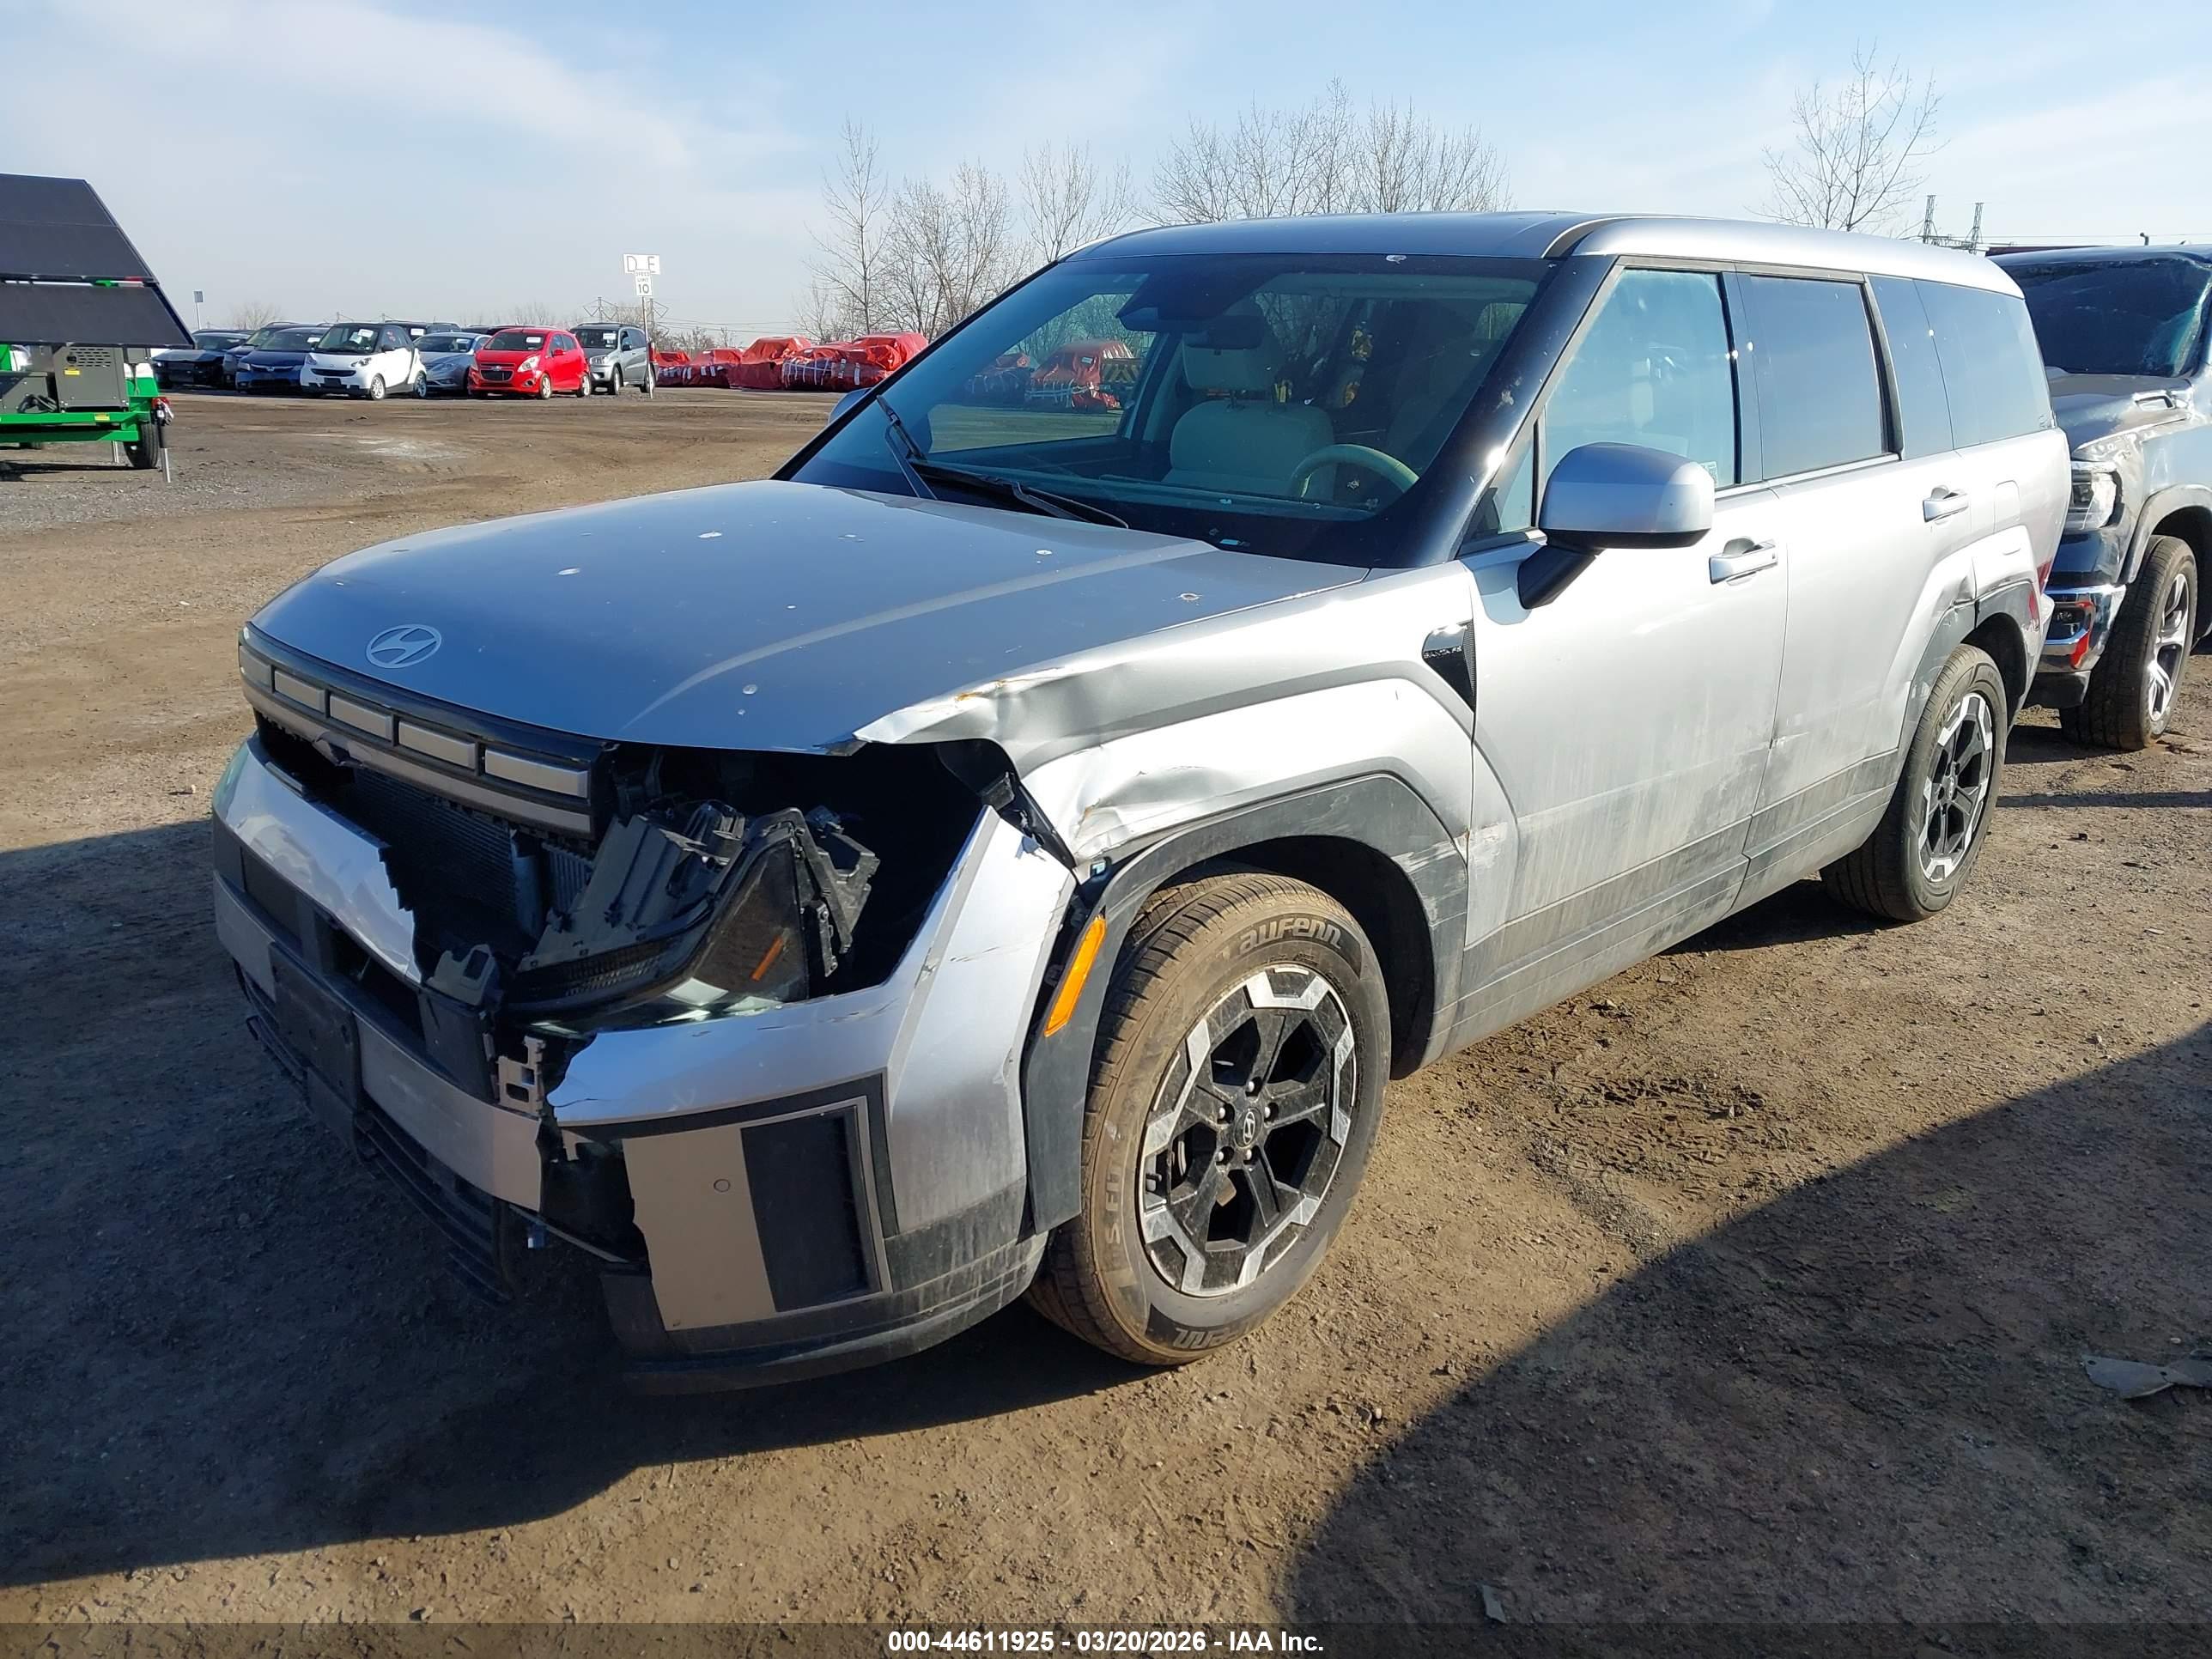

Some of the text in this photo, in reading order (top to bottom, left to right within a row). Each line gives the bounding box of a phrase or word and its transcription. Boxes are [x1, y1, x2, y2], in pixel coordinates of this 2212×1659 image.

[627, 255, 656, 273] D E
[638, 283, 650, 294] 10
